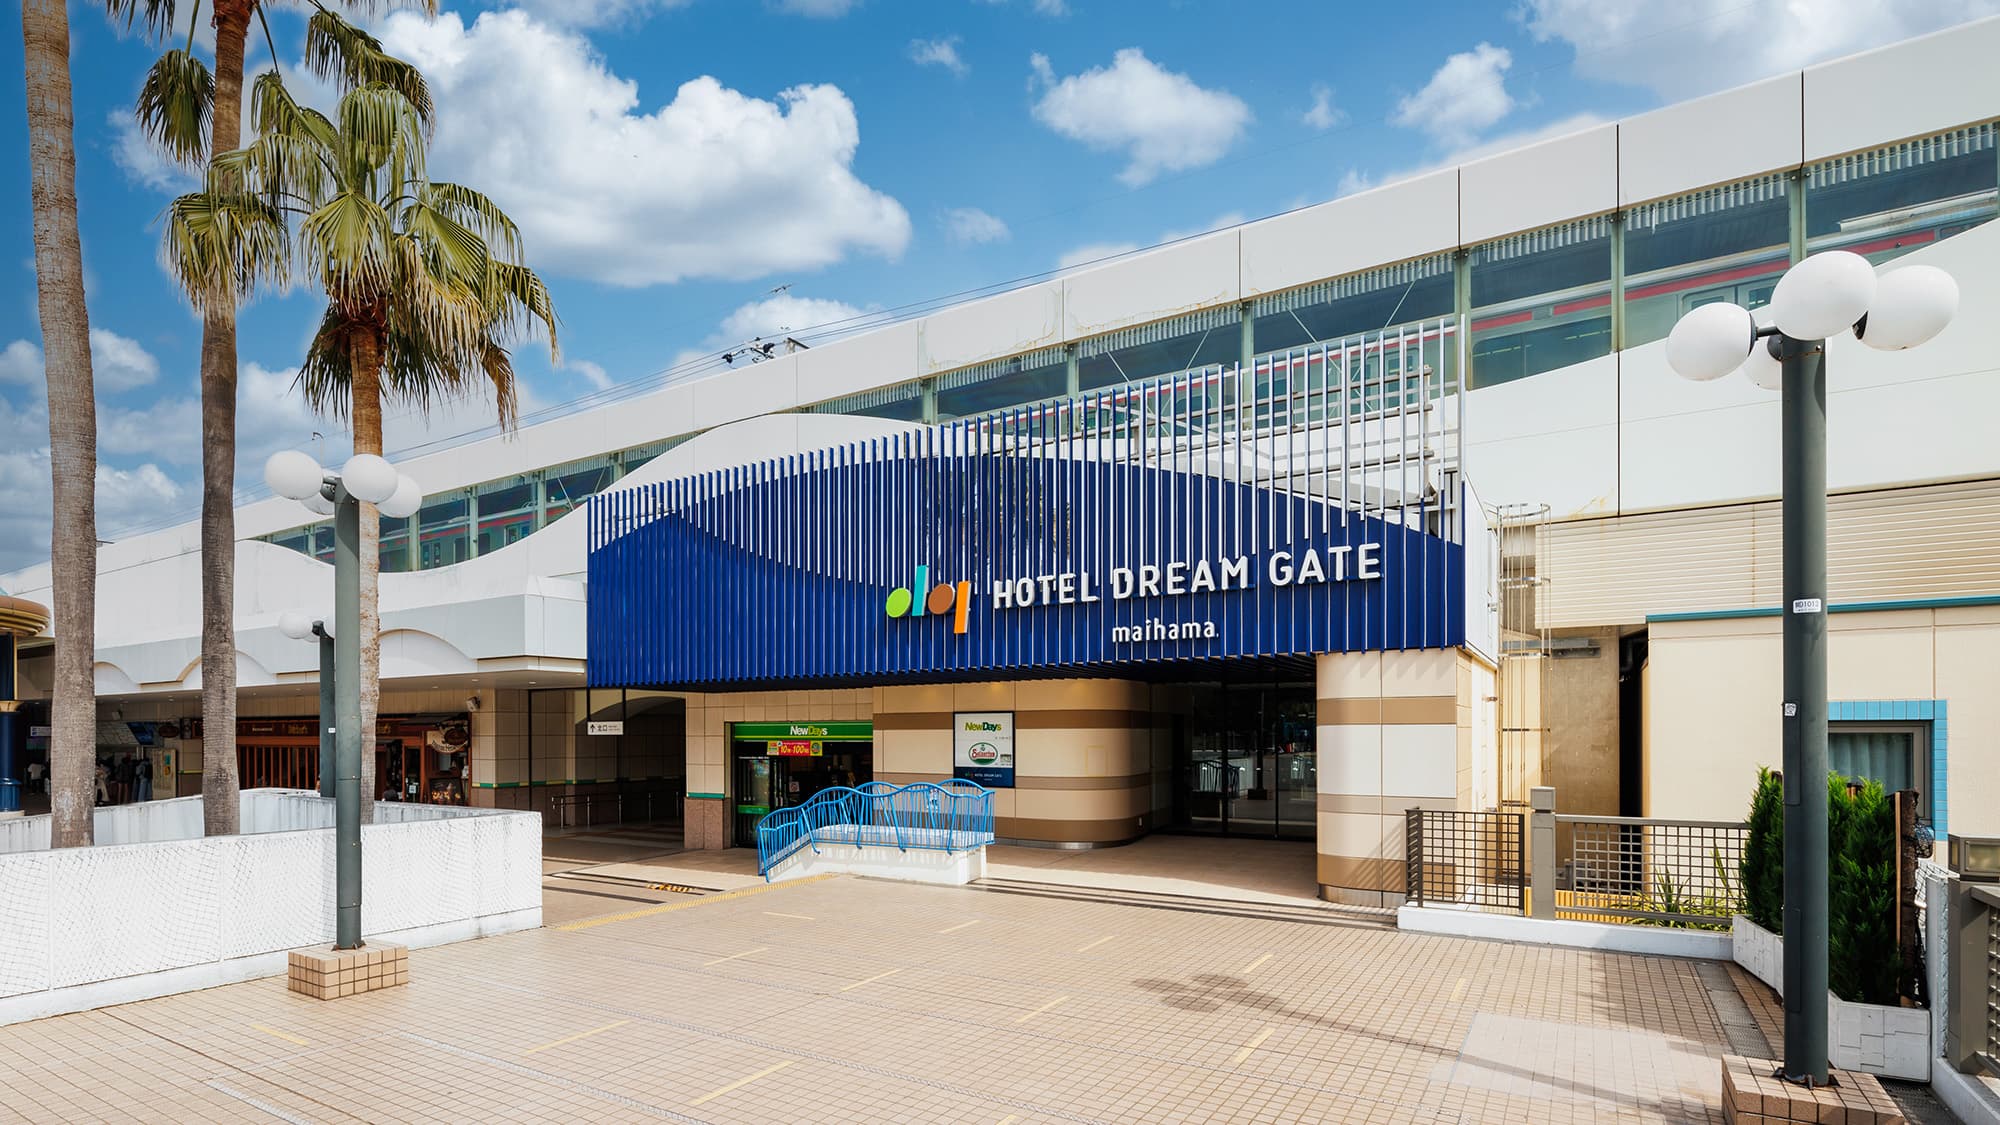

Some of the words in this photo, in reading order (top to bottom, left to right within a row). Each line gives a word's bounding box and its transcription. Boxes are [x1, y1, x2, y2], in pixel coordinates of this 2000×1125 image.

[993, 571, 1099, 610] HOTEL
[1113, 556, 1248, 599] DREAM
[1269, 543, 1381, 586] GATE
[1111, 616, 1216, 643] maihama
[790, 725, 828, 737] NewDays
[964, 721, 1002, 733] NewDays
